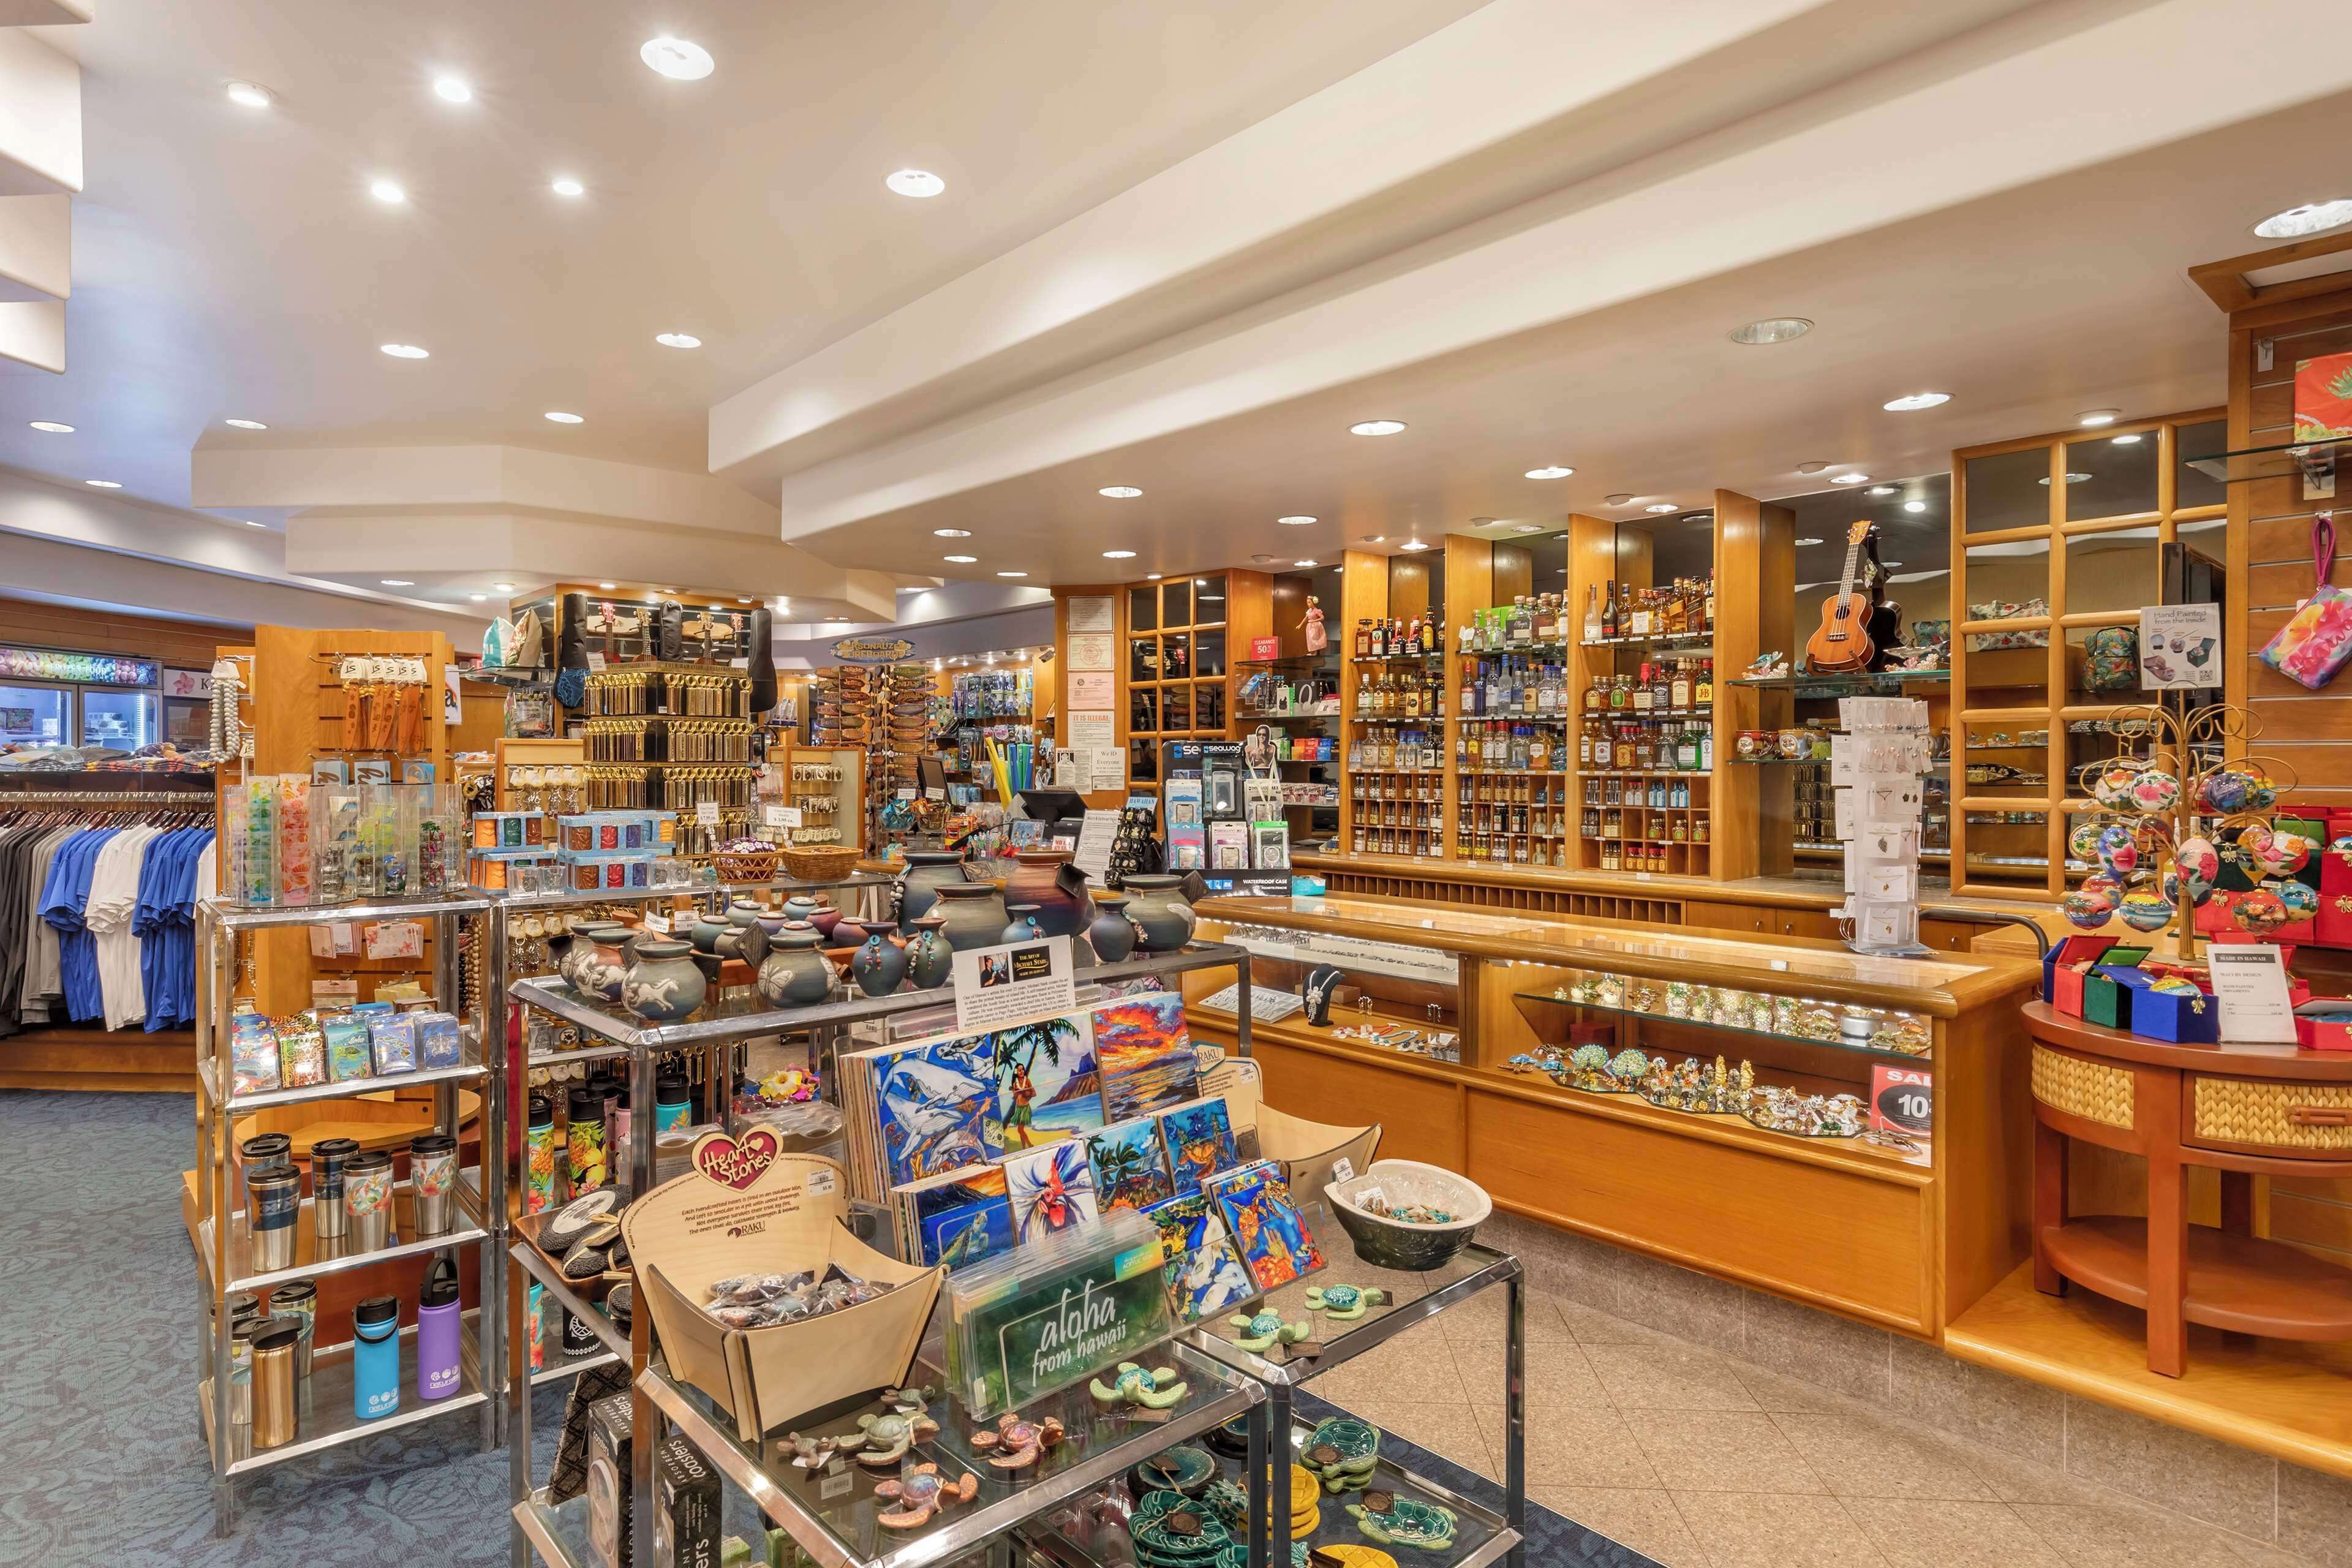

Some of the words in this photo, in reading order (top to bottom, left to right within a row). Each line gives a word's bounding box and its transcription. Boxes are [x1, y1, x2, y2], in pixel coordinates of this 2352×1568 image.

[1198, 1047, 1220, 1063] RAKU
[1887, 1070, 1932, 1086] SAL
[1898, 1094, 1931, 1119] 10
[704, 1137, 755, 1176] Heart
[719, 1151, 772, 1186] Stones
[696, 1201, 727, 1212] handcrafted
[733, 1216, 755, 1225] cultivate
[756, 1210, 777, 1219] strength
[707, 1215, 730, 1224] everyone
[742, 1220, 766, 1234] RAKU
[1123, 1257, 1142, 1270] ACRYLIC
[1041, 1279, 1116, 1352] aloha
[1032, 1348, 1071, 1387] from
[1077, 1318, 1126, 1359] hawaii
[601, 1401, 631, 1433] ABSORBENT
[613, 1396, 633, 1420] asters
[592, 1430, 609, 1457] coasters
[660, 1447, 687, 1483] ABSORBEN
[669, 1439, 706, 1478] coasters
